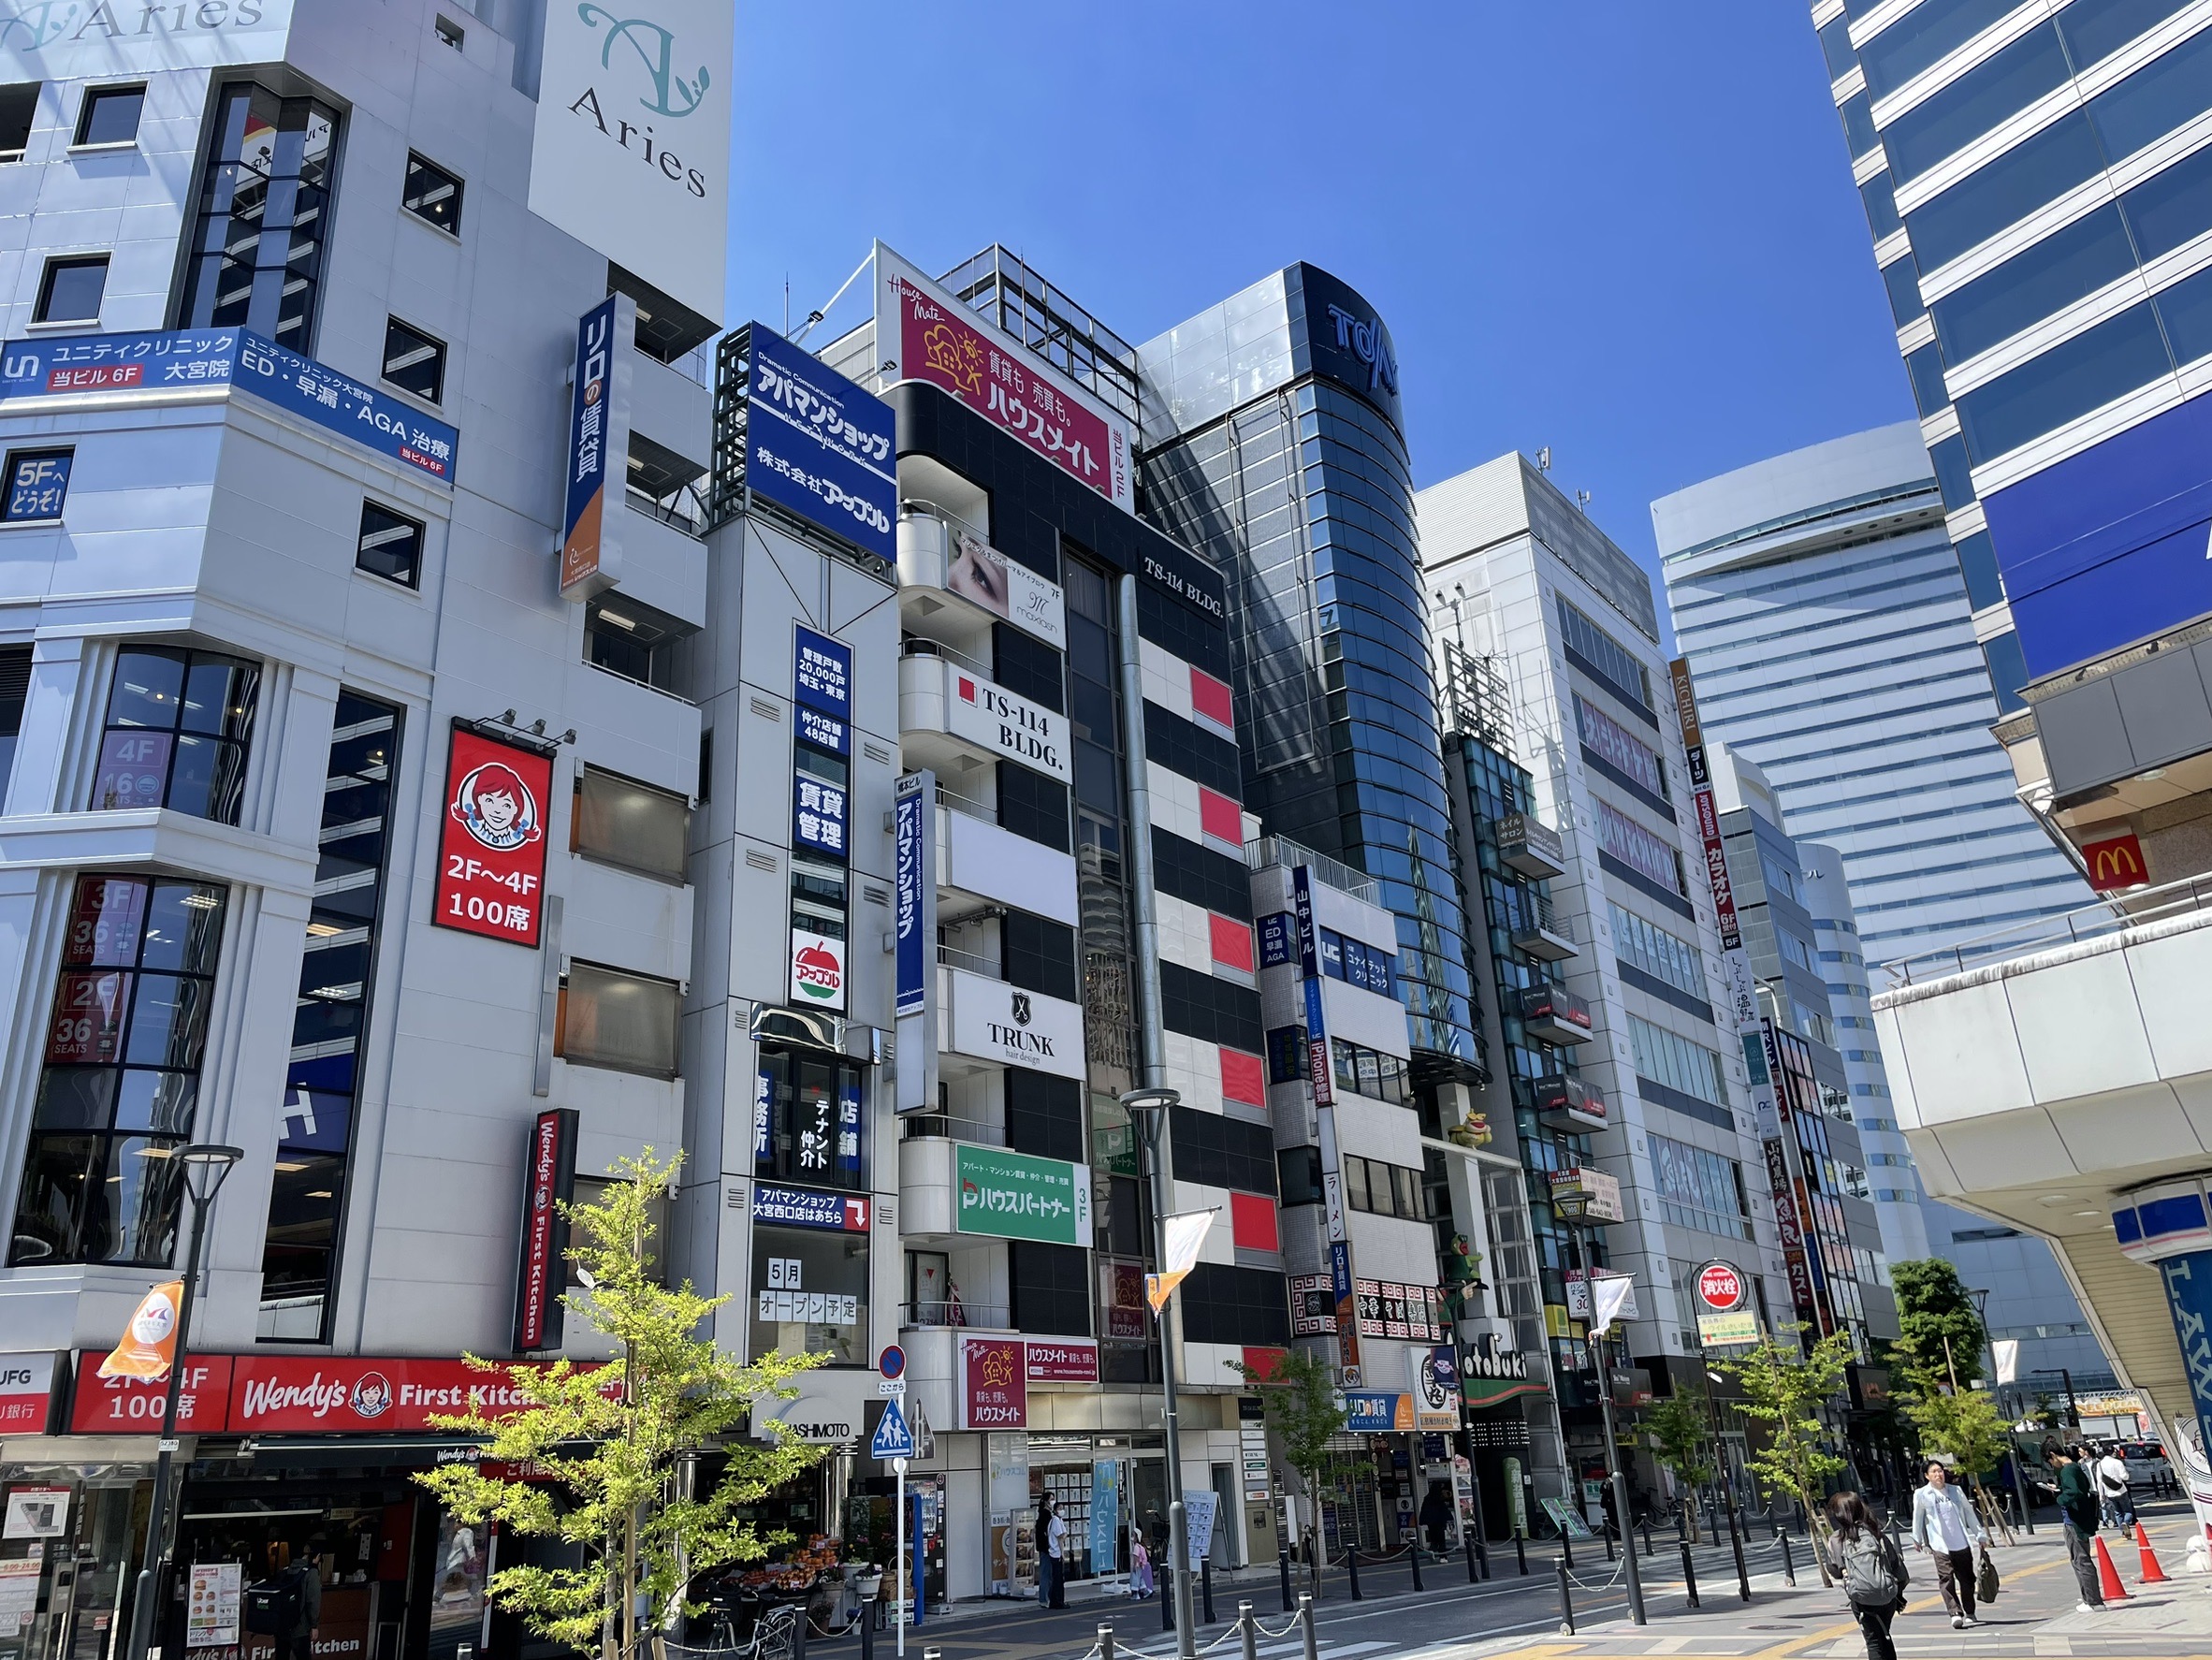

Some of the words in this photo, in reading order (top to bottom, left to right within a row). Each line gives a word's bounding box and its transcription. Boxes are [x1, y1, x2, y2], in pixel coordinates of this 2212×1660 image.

[68, 0, 263, 40] Aries
[567, 86, 708, 199] Aries
[887, 273, 924, 302] House
[914, 301, 946, 322] Mate
[51, 335, 233, 362] ユニティクリニック
[52, 371, 108, 387] 当ビル
[112, 366, 138, 383] 6F
[164, 359, 230, 381] 大宮院
[245, 337, 374, 404] ユニティクリニック大宮院
[758, 352, 793, 377] Dramatic
[793, 372, 846, 410] Communication
[989, 350, 1025, 394] 賃貸も
[575, 313, 606, 484] リロの賃貸
[758, 365, 891, 461] アパマンショップ
[987, 382, 1099, 477] ハウスメイト
[411, 428, 451, 461] 治療
[16, 460, 65, 487] 5Fへ
[401, 447, 429, 467] 当ビル
[429, 460, 444, 473] 6F
[11, 487, 62, 514] どうぞ!
[756, 446, 891, 533] 株式会社アップル
[1051, 588, 1060, 600] 7F
[1143, 556, 1184, 593] TS-114
[1186, 582, 1224, 619] BLDG.
[798, 659, 846, 687] 20,000戸
[802, 647, 843, 675] 管理戸数
[798, 671, 846, 702] 埼玉・東京
[982, 688, 1049, 737] TS-114
[1676, 675, 1695, 730] KICHIRI
[802, 709, 842, 737] 仲介店舗
[804, 725, 839, 750] 48店舗
[116, 738, 155, 763] 4F
[998, 722, 1064, 771] BLDG.
[1690, 750, 1704, 780] ダーツ
[104, 772, 135, 795] 16
[897, 777, 921, 794] 橋本ビル
[799, 779, 843, 820] 賃貸
[1500, 818, 1521, 830] ネイル
[1698, 794, 1715, 836] JOYSOUND
[798, 810, 843, 850] 管理
[1500, 828, 1523, 839] サロン
[897, 801, 914, 939] アパマンショップ
[915, 837, 924, 901] Communication
[1708, 847, 1731, 906] カラオケ
[91, 884, 131, 910] 3F
[447, 892, 531, 932] 100席
[1297, 889, 1314, 954] 山中ビル
[1720, 913, 1736, 925] 6F
[74, 920, 110, 944] 36
[1265, 926, 1281, 939] ED
[1722, 923, 1737, 932] 受付
[1725, 936, 1739, 947] 5F
[72, 944, 106, 955] SEATS
[1266, 952, 1285, 963] AGA
[795, 962, 840, 993] アップル
[1347, 954, 1386, 975] ユナイテッド
[1355, 969, 1388, 989] クリニック
[1731, 956, 1747, 993] しゃぶしゃぶ
[73, 980, 114, 1007] 2F
[56, 1017, 93, 1043] 36
[987, 1022, 1055, 1058] TRUNK
[54, 1042, 88, 1055] SEATS
[1005, 1047, 1019, 1059] hair
[1019, 1050, 1041, 1066] design
[1311, 1041, 1330, 1103] iPhone修理
[815, 1099, 830, 1170] テナント
[838, 1099, 859, 1158] 店舗
[537, 1121, 554, 1182] Wendy's
[800, 1129, 815, 1169] 仲介
[1768, 1143, 1788, 1191] 山内農場
[752, 1201, 843, 1225] 大宮西口店はあちら
[761, 1188, 837, 1210] アパマンショップ
[979, 1187, 1070, 1218] ハウスパートナー
[1328, 1176, 1343, 1238] ラーメン
[1775, 1197, 1800, 1245] 魚民
[533, 1216, 545, 1260] First
[771, 1264, 799, 1282] 5月
[1334, 1246, 1347, 1290] リロの賃貸
[1702, 1278, 1738, 1295] 消火栓
[1791, 1262, 1809, 1304] ガスト
[528, 1264, 542, 1341] Kitchen
[760, 1295, 855, 1318] オープン予定
[1027, 1347, 1068, 1363] ハウスメイト
[242, 1372, 347, 1419] Wendy's
[399, 1383, 463, 1406] First
[880, 1383, 905, 1392] ここから
[975, 1405, 1021, 1422] ハウスメイト
[1349, 1398, 1388, 1418] リロの賃貸
[436, 1449, 467, 1463] Wendy's
